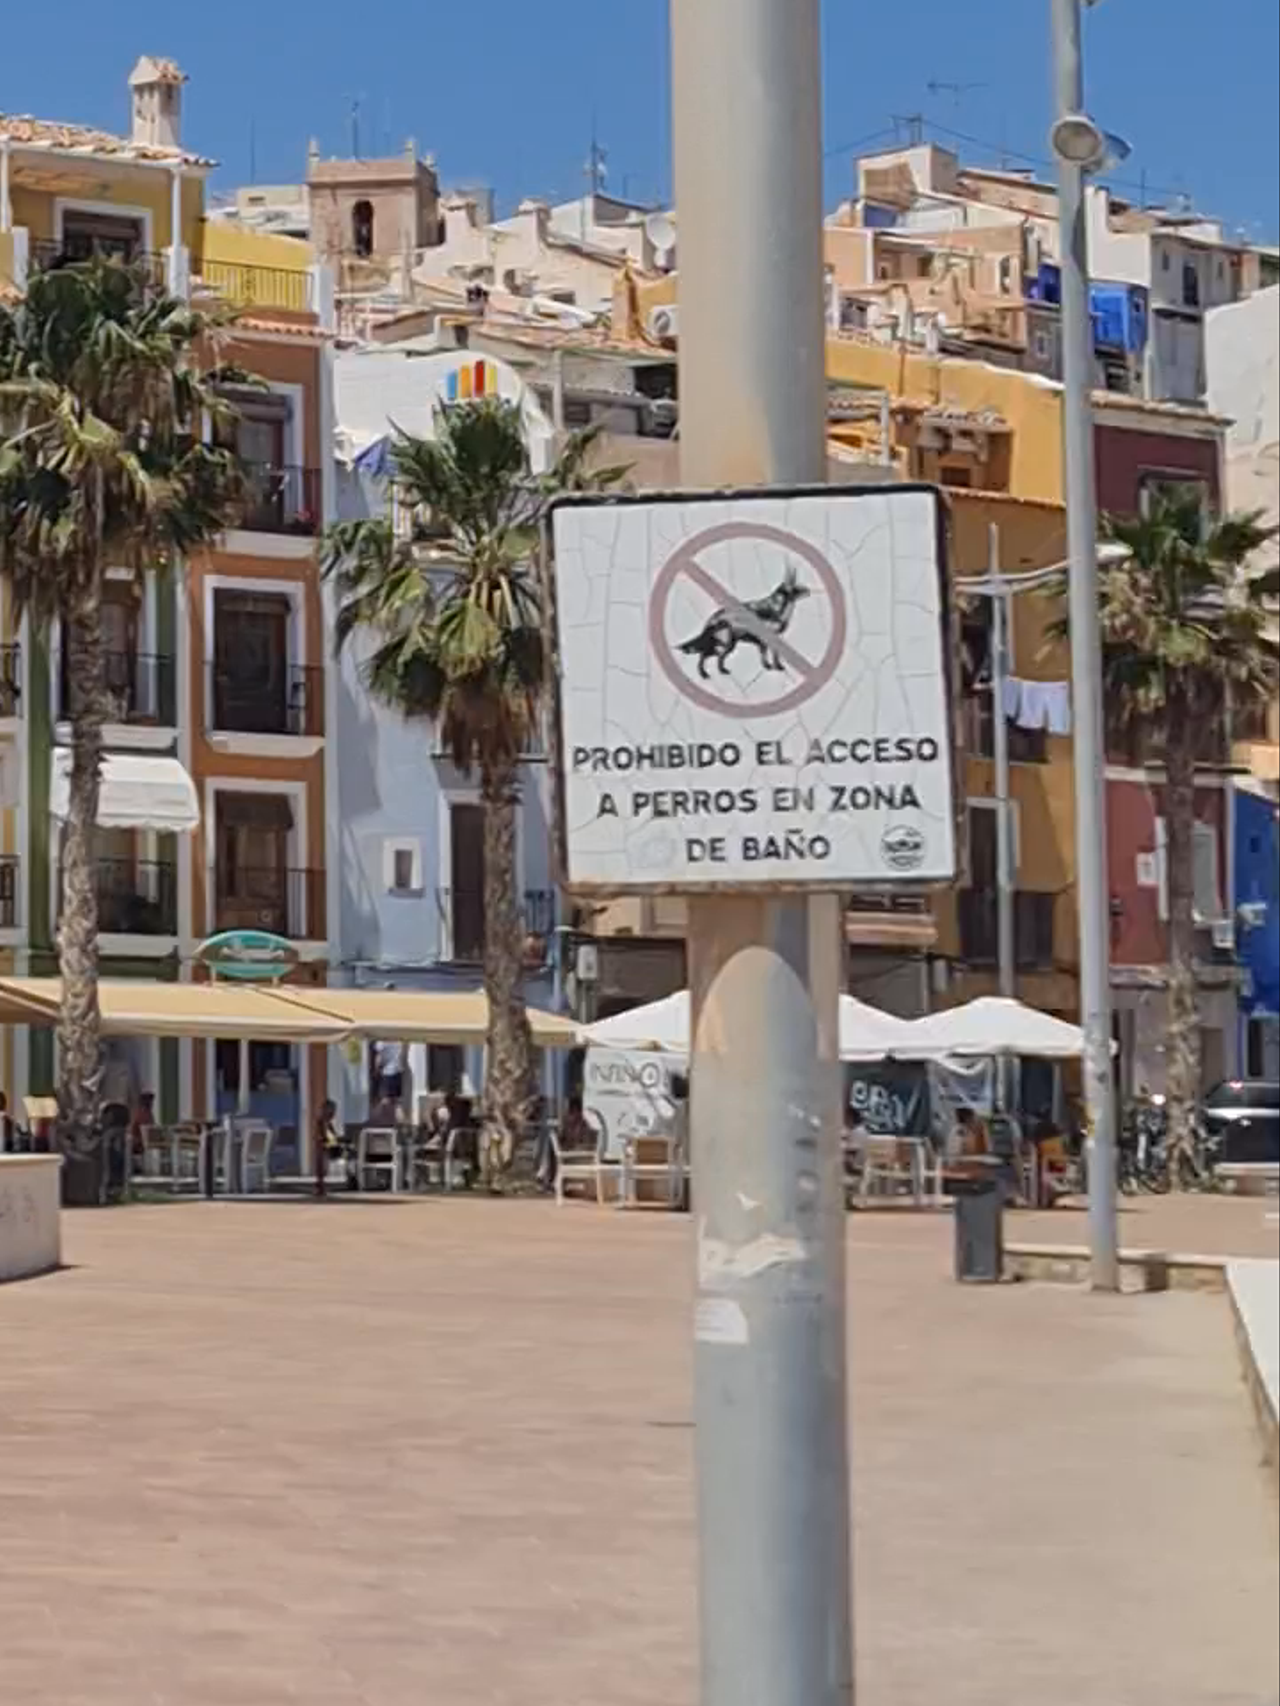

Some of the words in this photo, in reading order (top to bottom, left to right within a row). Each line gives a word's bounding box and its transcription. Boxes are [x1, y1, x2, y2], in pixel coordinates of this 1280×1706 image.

[572, 742, 740, 771] PROHIBIDO
[756, 740, 791, 766] EL
[807, 737, 939, 764] ACCESO
[596, 793, 618, 817] A
[632, 788, 757, 817] PERROS
[773, 786, 814, 812] EN
[829, 784, 922, 811] ZONA
[686, 838, 726, 862] DE
[742, 828, 831, 861] BAÑO
